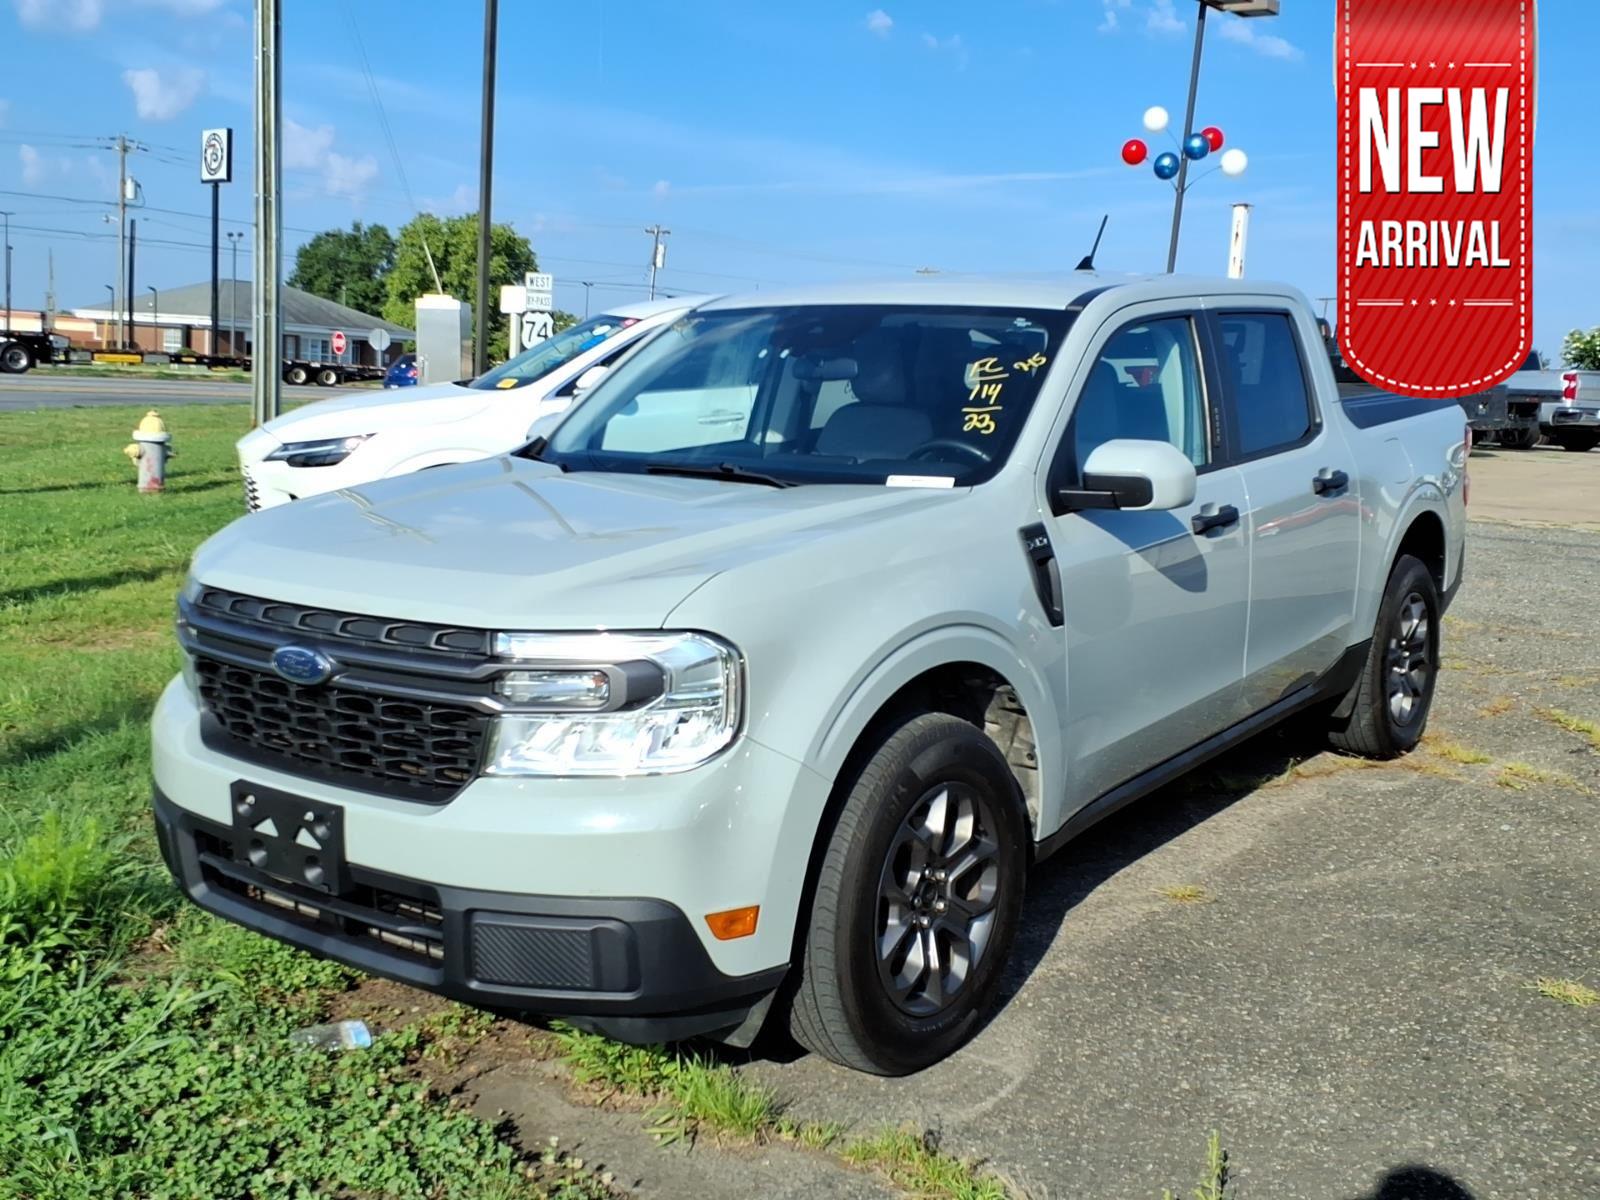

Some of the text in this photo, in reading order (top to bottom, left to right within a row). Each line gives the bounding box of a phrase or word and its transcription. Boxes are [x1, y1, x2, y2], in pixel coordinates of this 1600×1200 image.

[529, 276, 550, 287] WEST
[527, 295, 551, 306] BY-PASS
[525, 320, 548, 342] 74
[962, 413, 996, 434] 23
